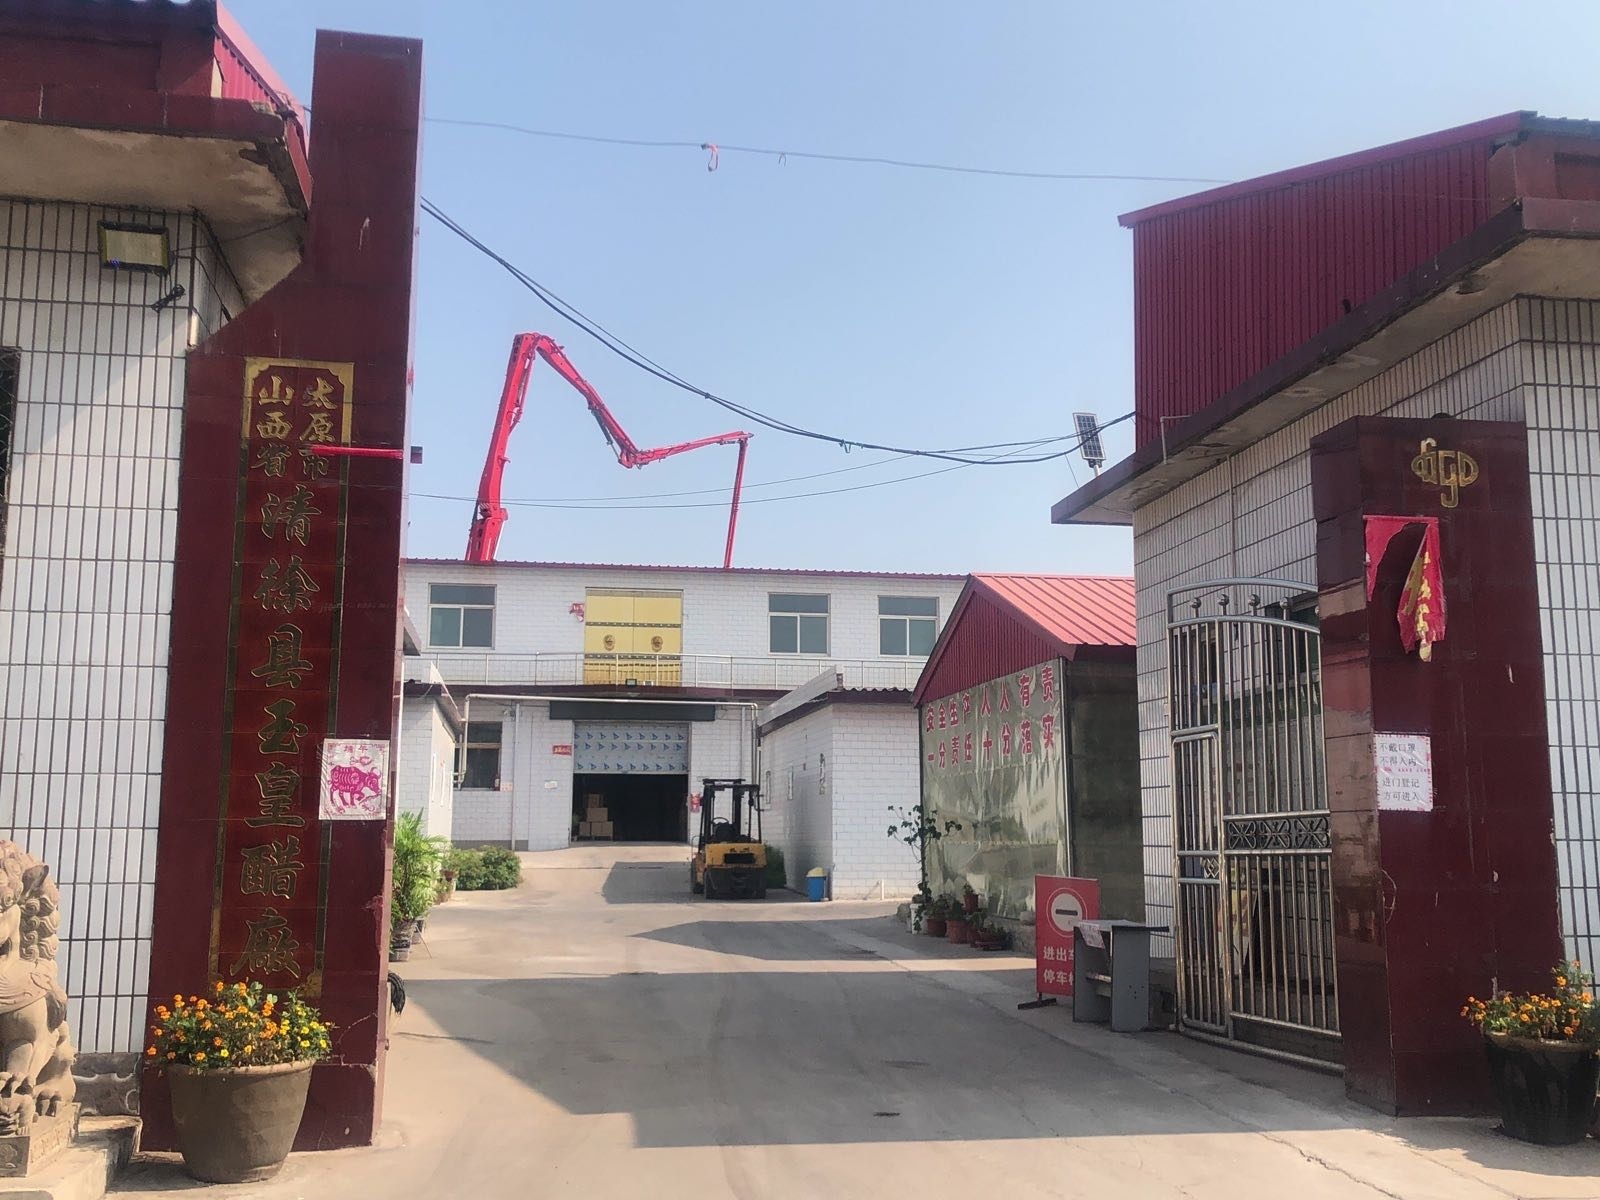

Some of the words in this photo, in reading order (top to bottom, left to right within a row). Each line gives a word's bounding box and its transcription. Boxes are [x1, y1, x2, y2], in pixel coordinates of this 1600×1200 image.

[251, 375, 295, 478] 山西省
[299, 377, 338, 481] 太原市
[926, 664, 1055, 733] 安全生产人人有责
[927, 713, 1055, 769] 一分责任十分落实
[1380, 757, 1417, 767] 不得入内
[1383, 777, 1420, 788] 进门登记
[1383, 791, 1420, 802] 方可进入
